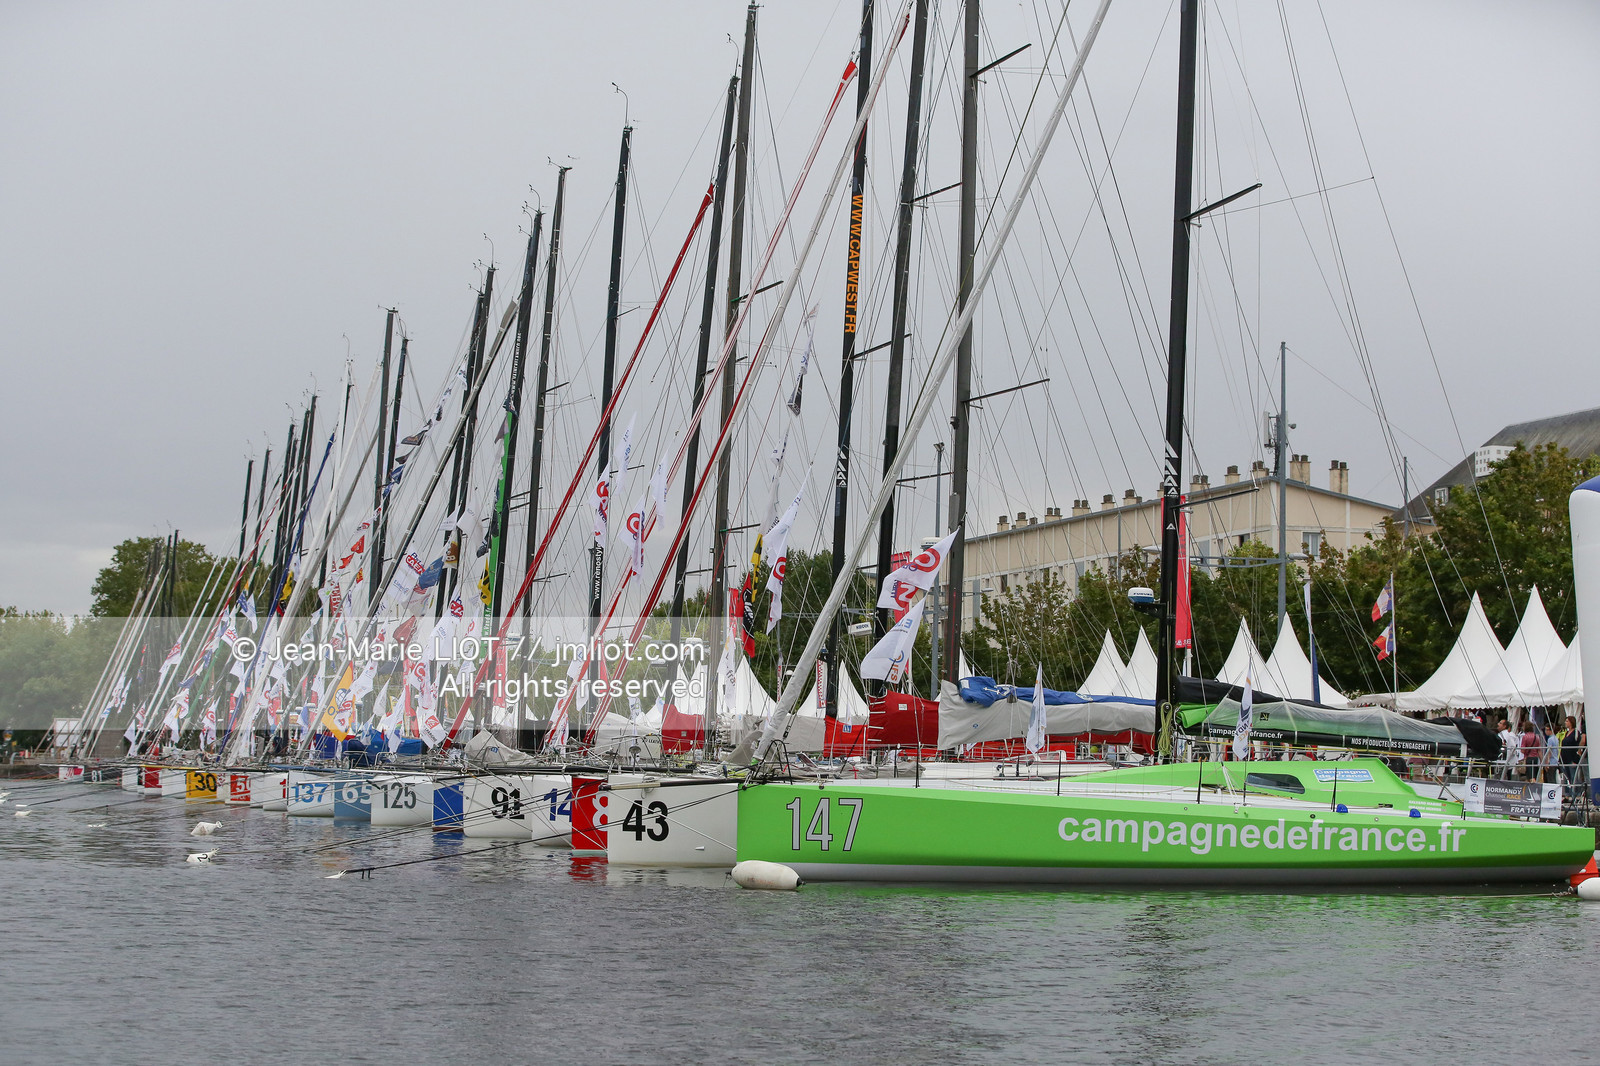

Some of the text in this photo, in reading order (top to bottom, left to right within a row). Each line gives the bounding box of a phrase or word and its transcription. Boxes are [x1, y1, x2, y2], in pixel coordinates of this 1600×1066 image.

[845, 194, 864, 333] WWW.CAPWEST.FR
[1208, 728, 1283, 739] campagefrance.fr
[1351, 737, 1361, 745] NOS
[1398, 742, 1427, 751] S'ENGAGENT
[194, 772, 217, 792] 30
[291, 782, 329, 803] 137
[342, 782, 372, 805] 65
[1485, 786, 1522, 795] NORMANDY
[380, 782, 417, 809] 125
[491, 786, 525, 820] 91
[622, 799, 670, 841] 43
[1527, 807, 1540, 815] 147
[786, 796, 863, 852] 147
[1057, 817, 1467, 855] campagnedefrance.fr
